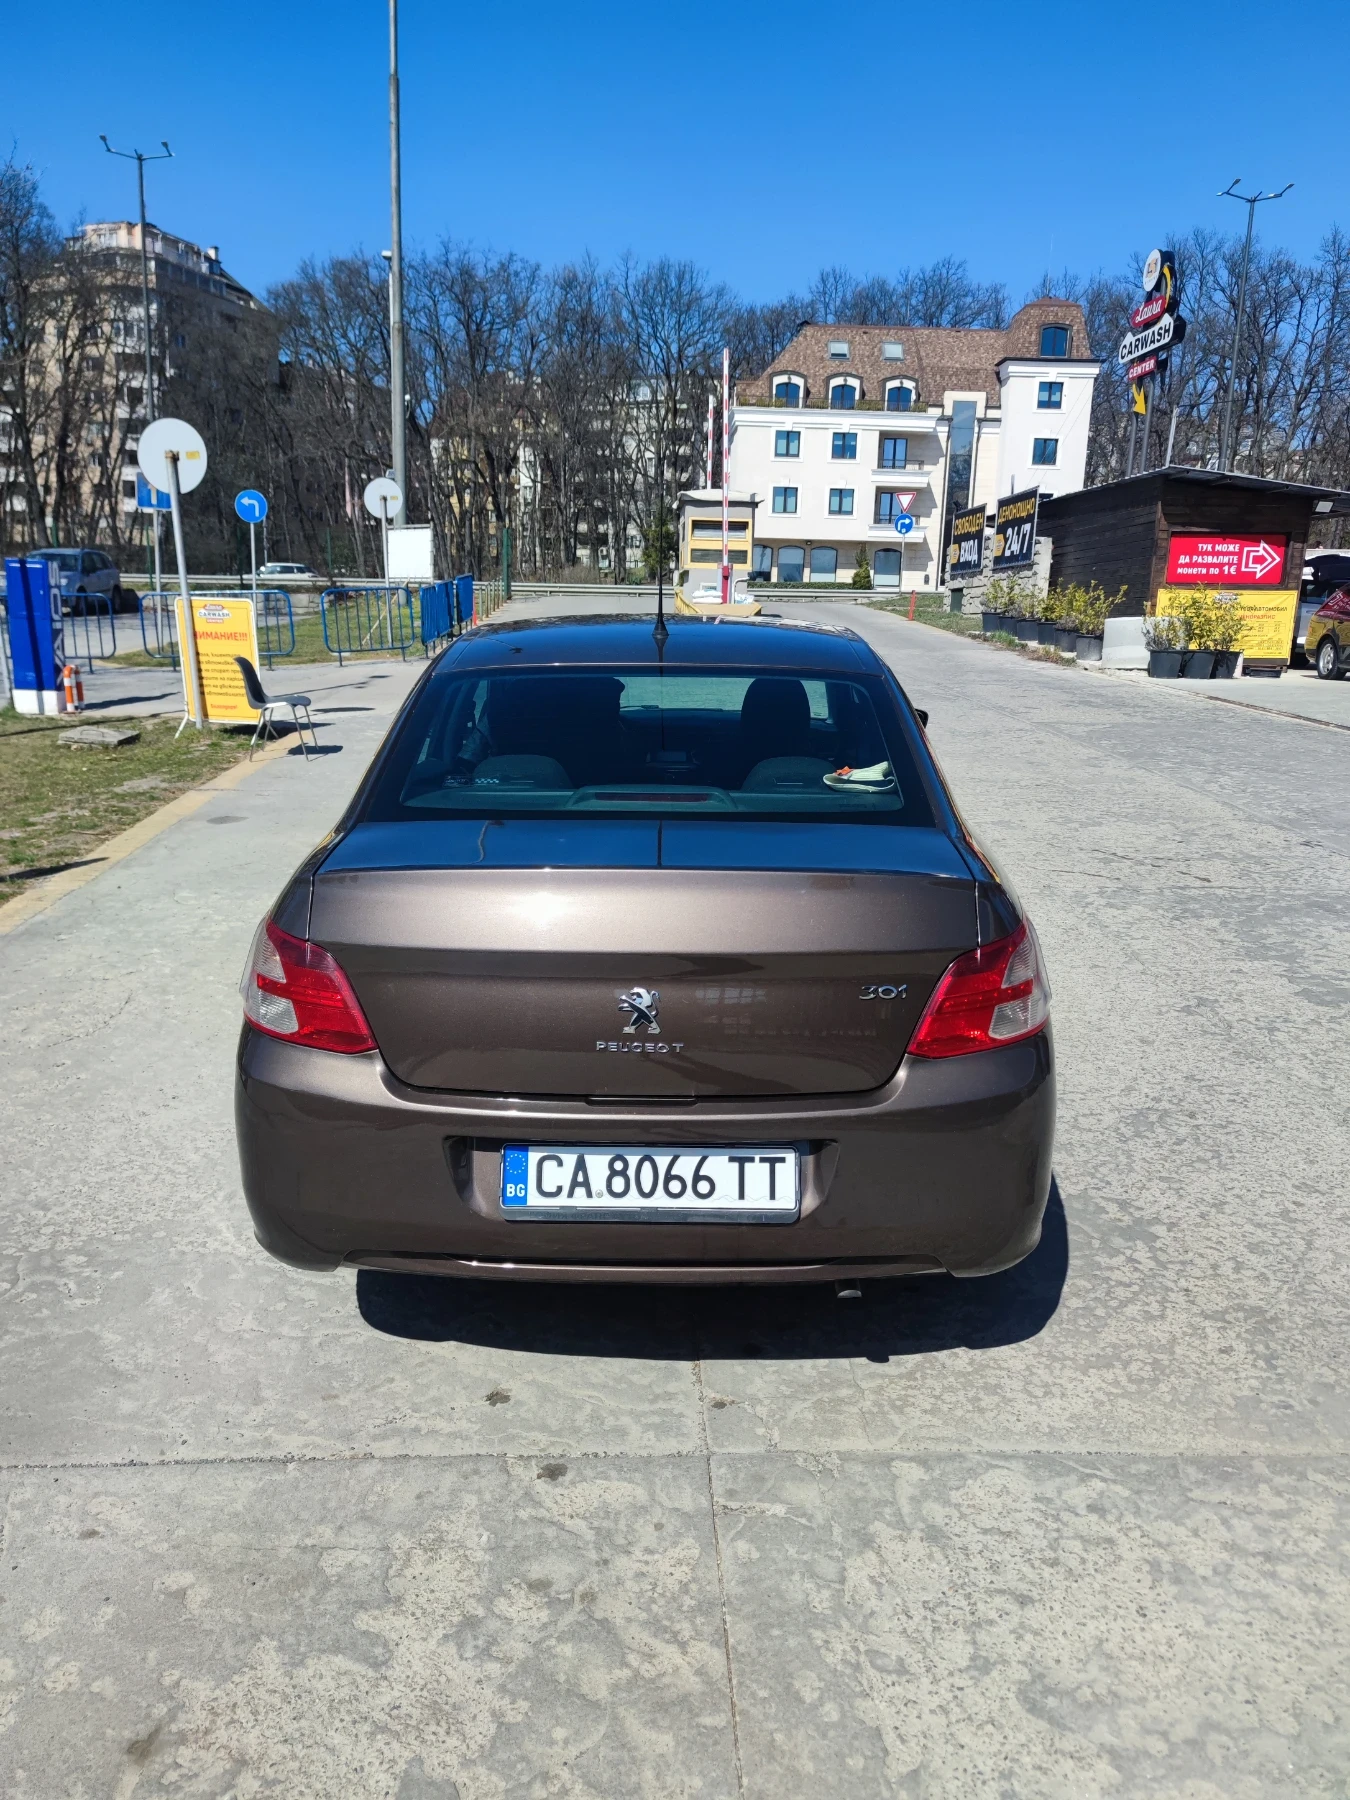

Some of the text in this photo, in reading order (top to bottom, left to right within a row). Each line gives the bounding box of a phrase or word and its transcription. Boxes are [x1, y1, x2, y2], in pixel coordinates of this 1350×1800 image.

[1135, 299, 1163, 324] Laura
[1120, 321, 1172, 360] CARWASH
[1128, 359, 1155, 379] CENTER
[998, 497, 1035, 525] ДЕНОНОЩНО
[954, 512, 984, 535] СВОБОДЕН
[1004, 523, 1032, 557] 24/7
[1198, 543, 1240, 552] ТУК МОЖЕ
[960, 539, 978, 564] ВХОД
[1178, 555, 1239, 564] ДА РАЗВАЛИТЕ
[1177, 565, 1237, 575] монети по 1€
[194, 631, 248, 641] ИМАНИЕ!!!
[859, 984, 908, 1000] 301
[596, 1041, 685, 1054] PEUGEOT
[506, 1183, 526, 1197] BG
